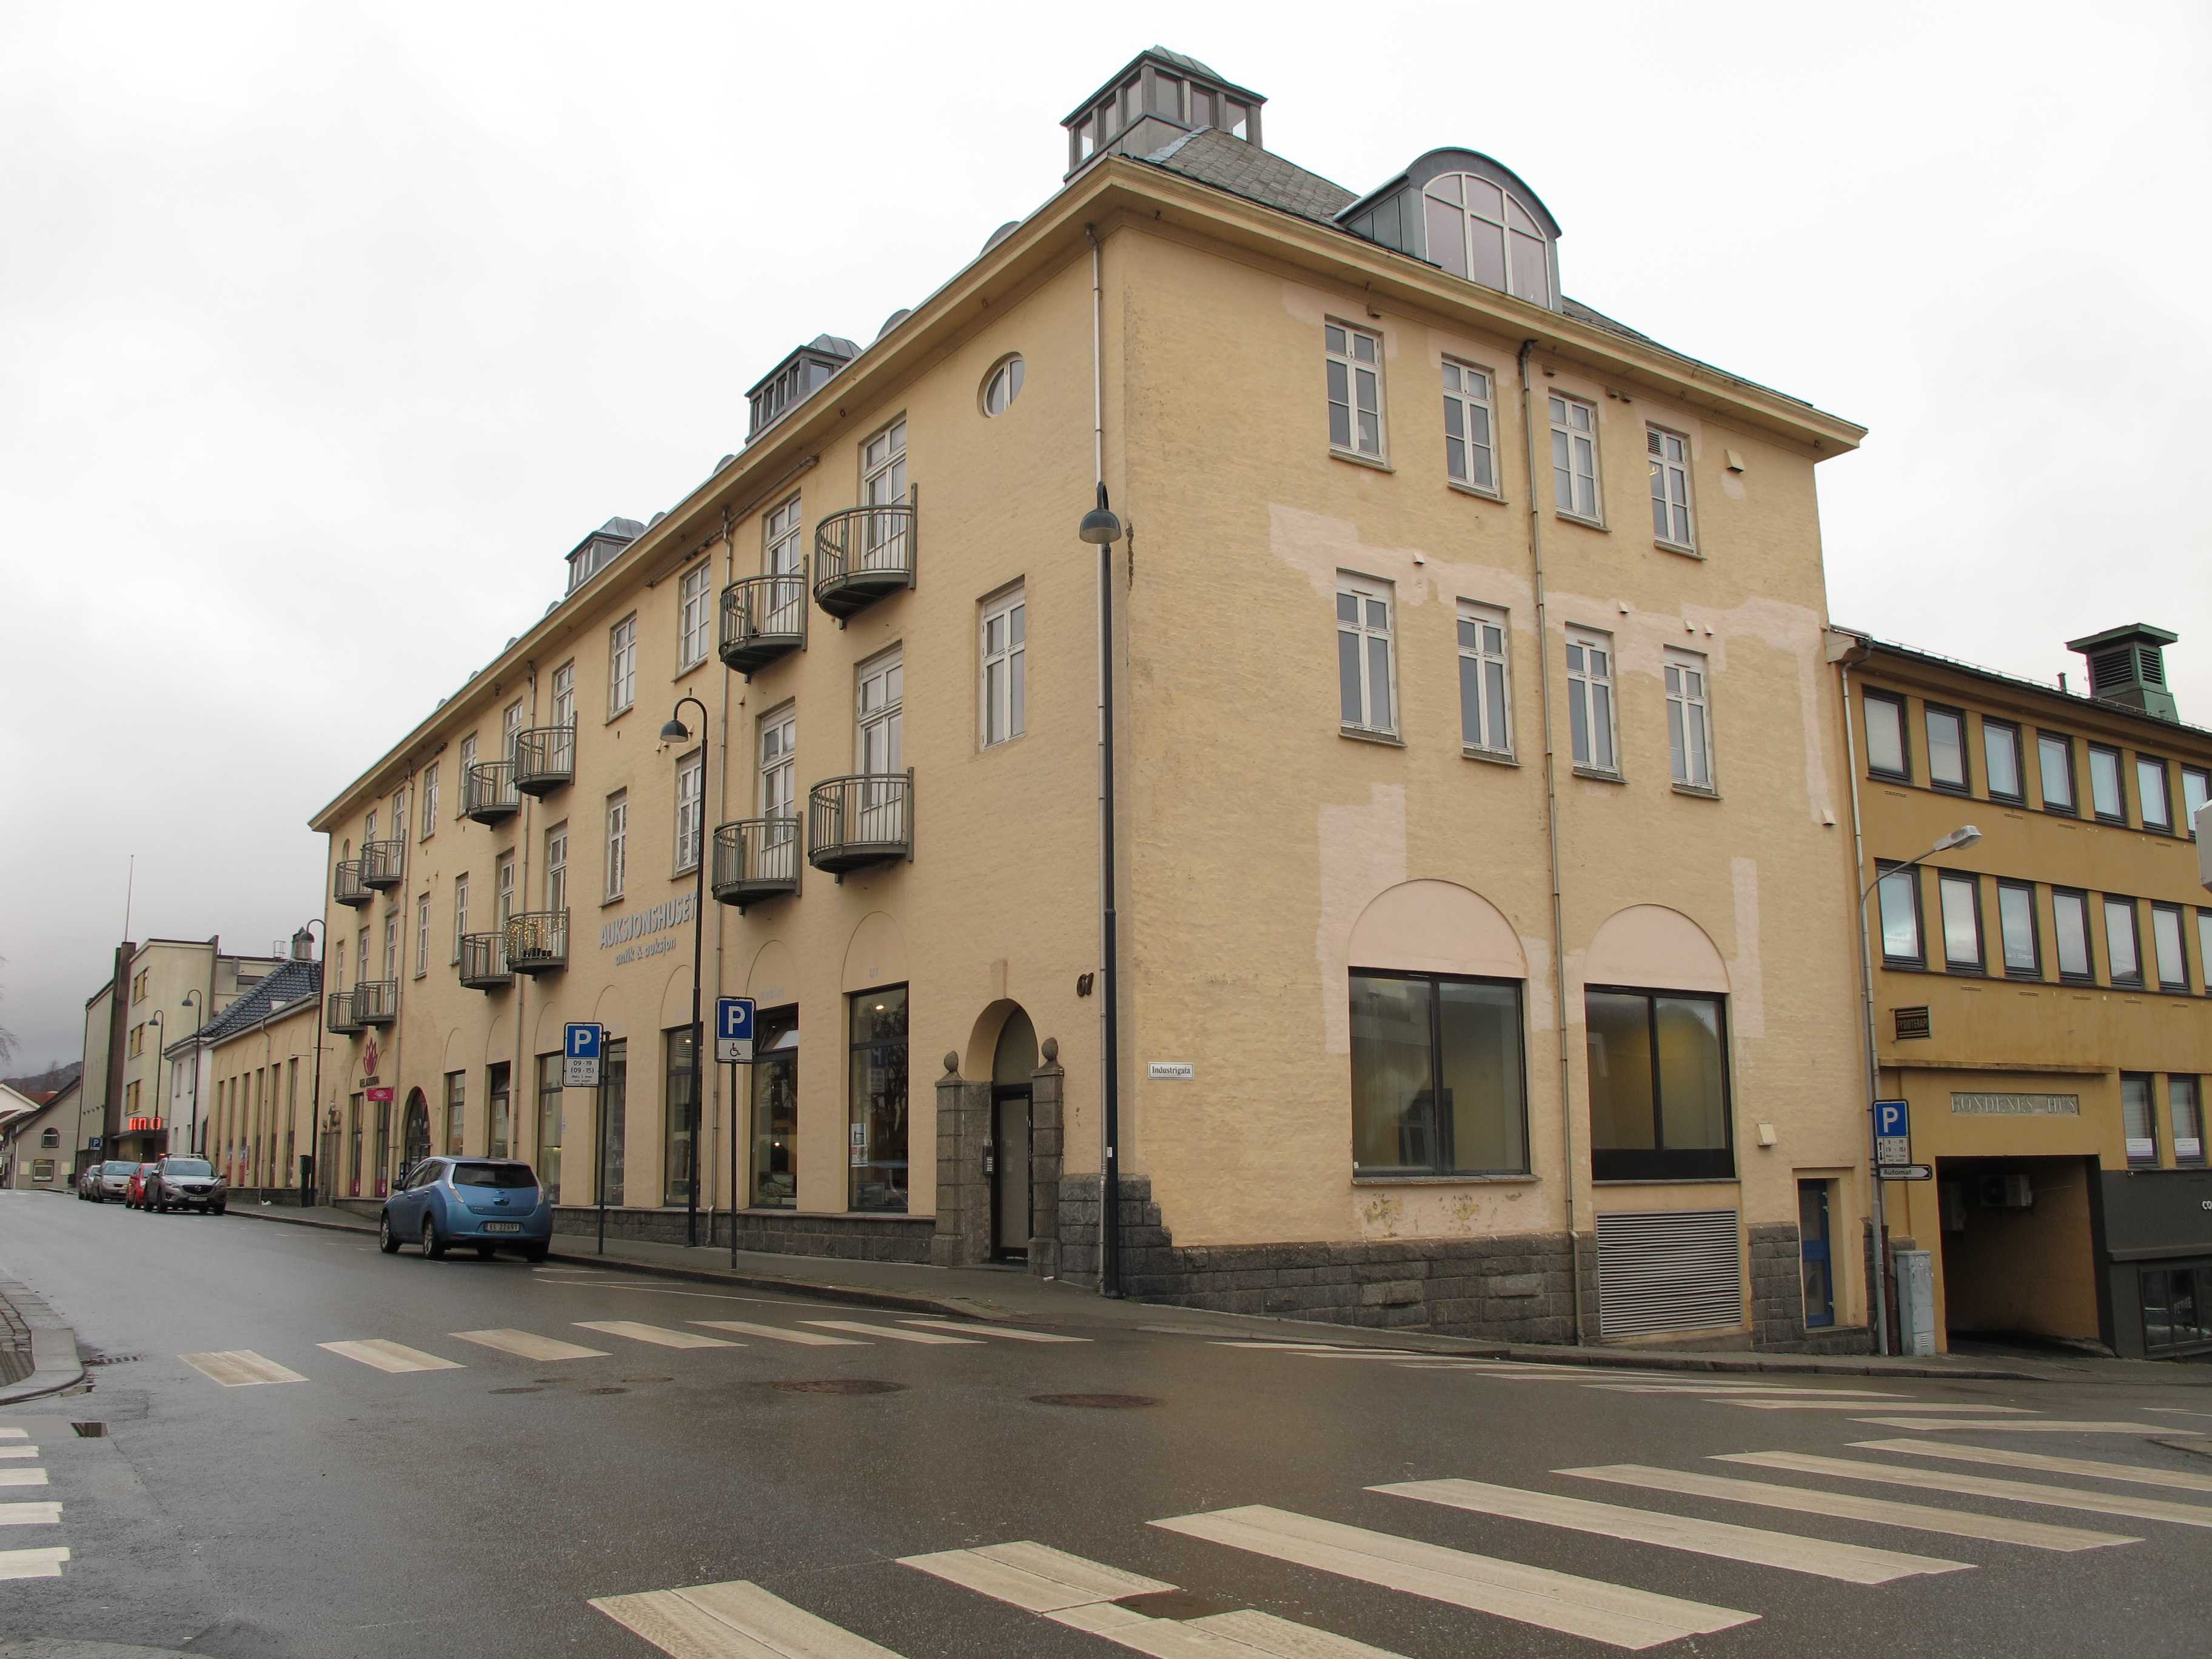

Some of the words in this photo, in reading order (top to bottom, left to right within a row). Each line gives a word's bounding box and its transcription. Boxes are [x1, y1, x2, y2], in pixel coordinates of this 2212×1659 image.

[600, 892, 697, 950] AUKSJONSHUSET
[616, 948, 635, 966] antik
[637, 946, 644, 960] &
[645, 937, 677, 957] auksjon
[728, 1006, 745, 1034] P
[1897, 1018, 1928, 1030] FYSIOTERAPI
[574, 1030, 592, 1053] P
[1152, 1066, 1190, 1076] Industrigata
[1951, 1096, 2033, 1113] BONDENES
[2047, 1096, 2076, 1113] HUS
[1882, 1107, 1899, 1133] P
